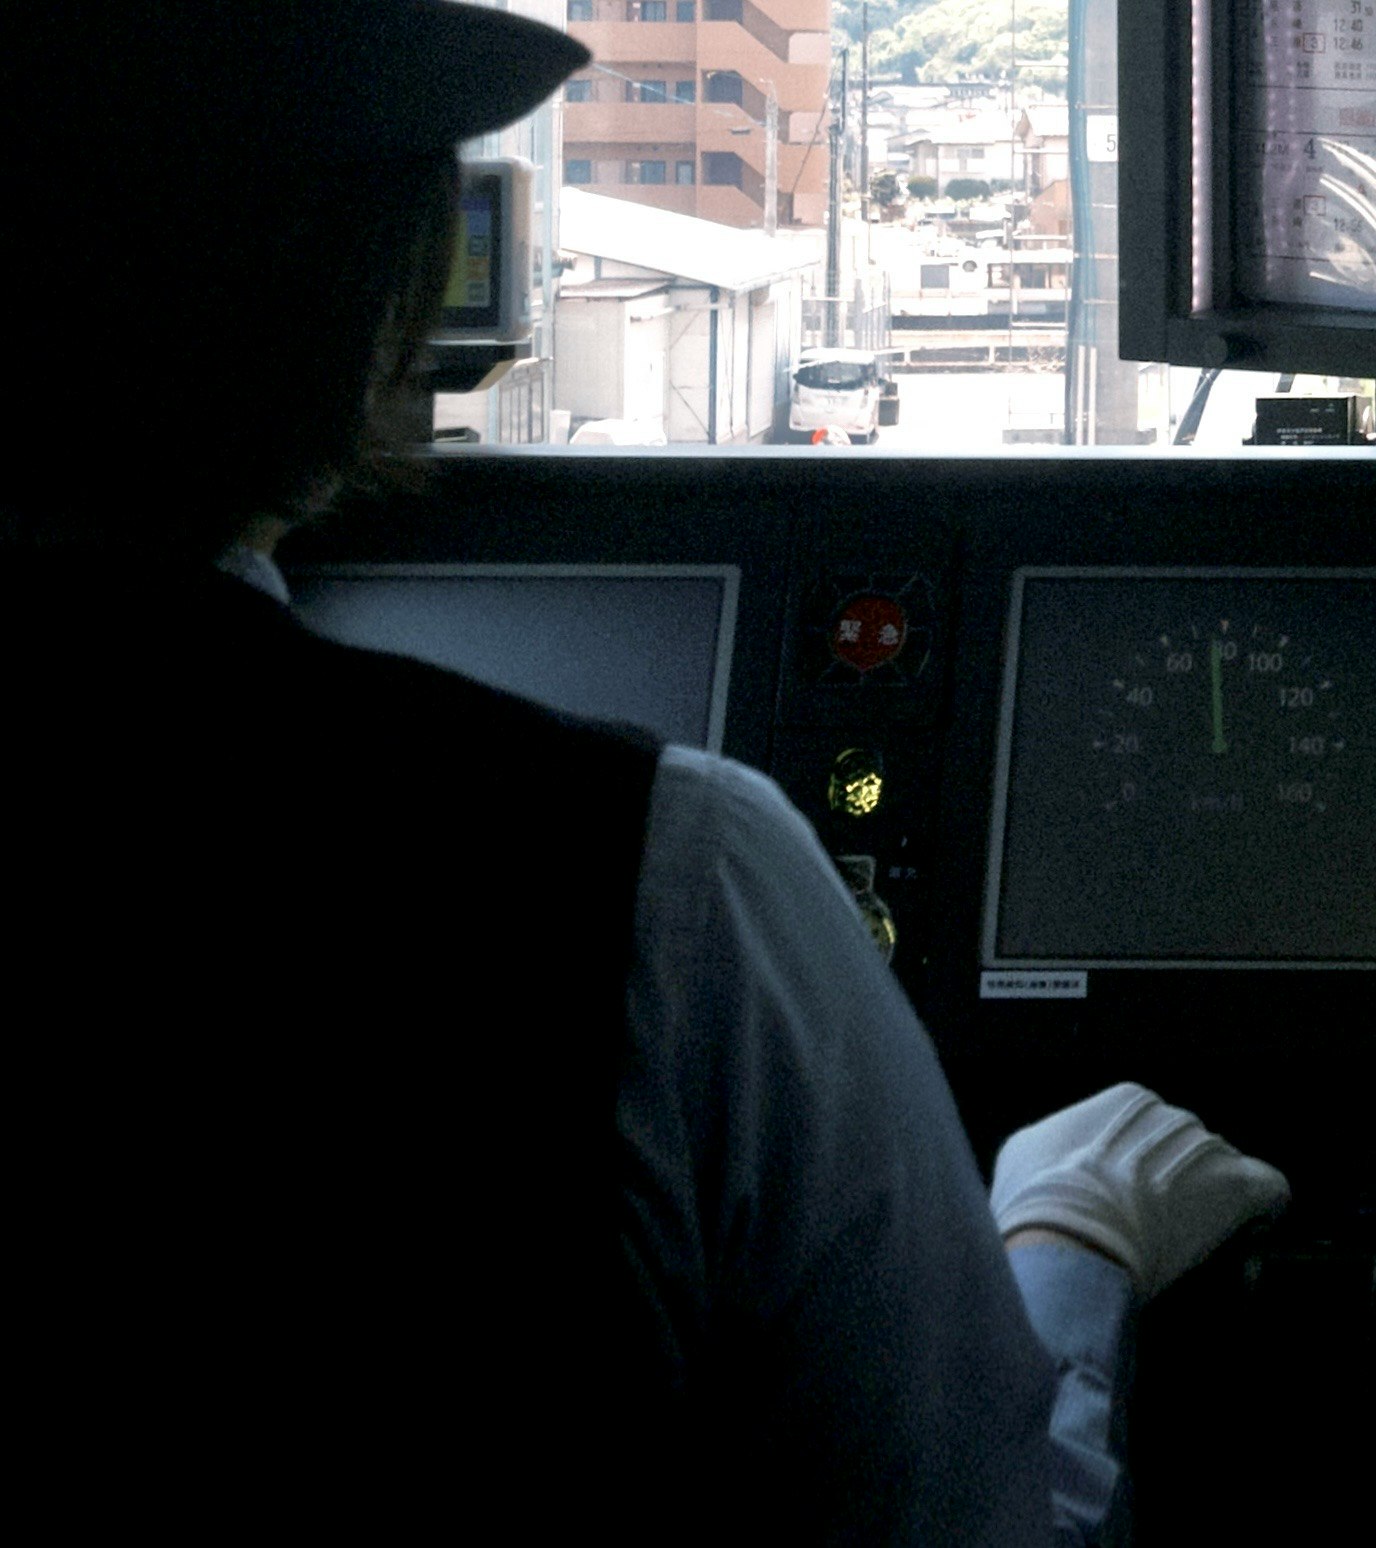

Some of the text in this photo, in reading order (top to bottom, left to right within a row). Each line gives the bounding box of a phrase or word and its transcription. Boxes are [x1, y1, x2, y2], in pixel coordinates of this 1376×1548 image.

[1106, 133, 1117, 153] 5
[1166, 652, 1193, 673] 60
[1250, 652, 1283, 673] 100
[1126, 686, 1153, 707] 40
[1279, 686, 1315, 708] 120
[1113, 733, 1140, 754] 20
[1289, 735, 1326, 756] 140
[1278, 782, 1313, 802] 160
